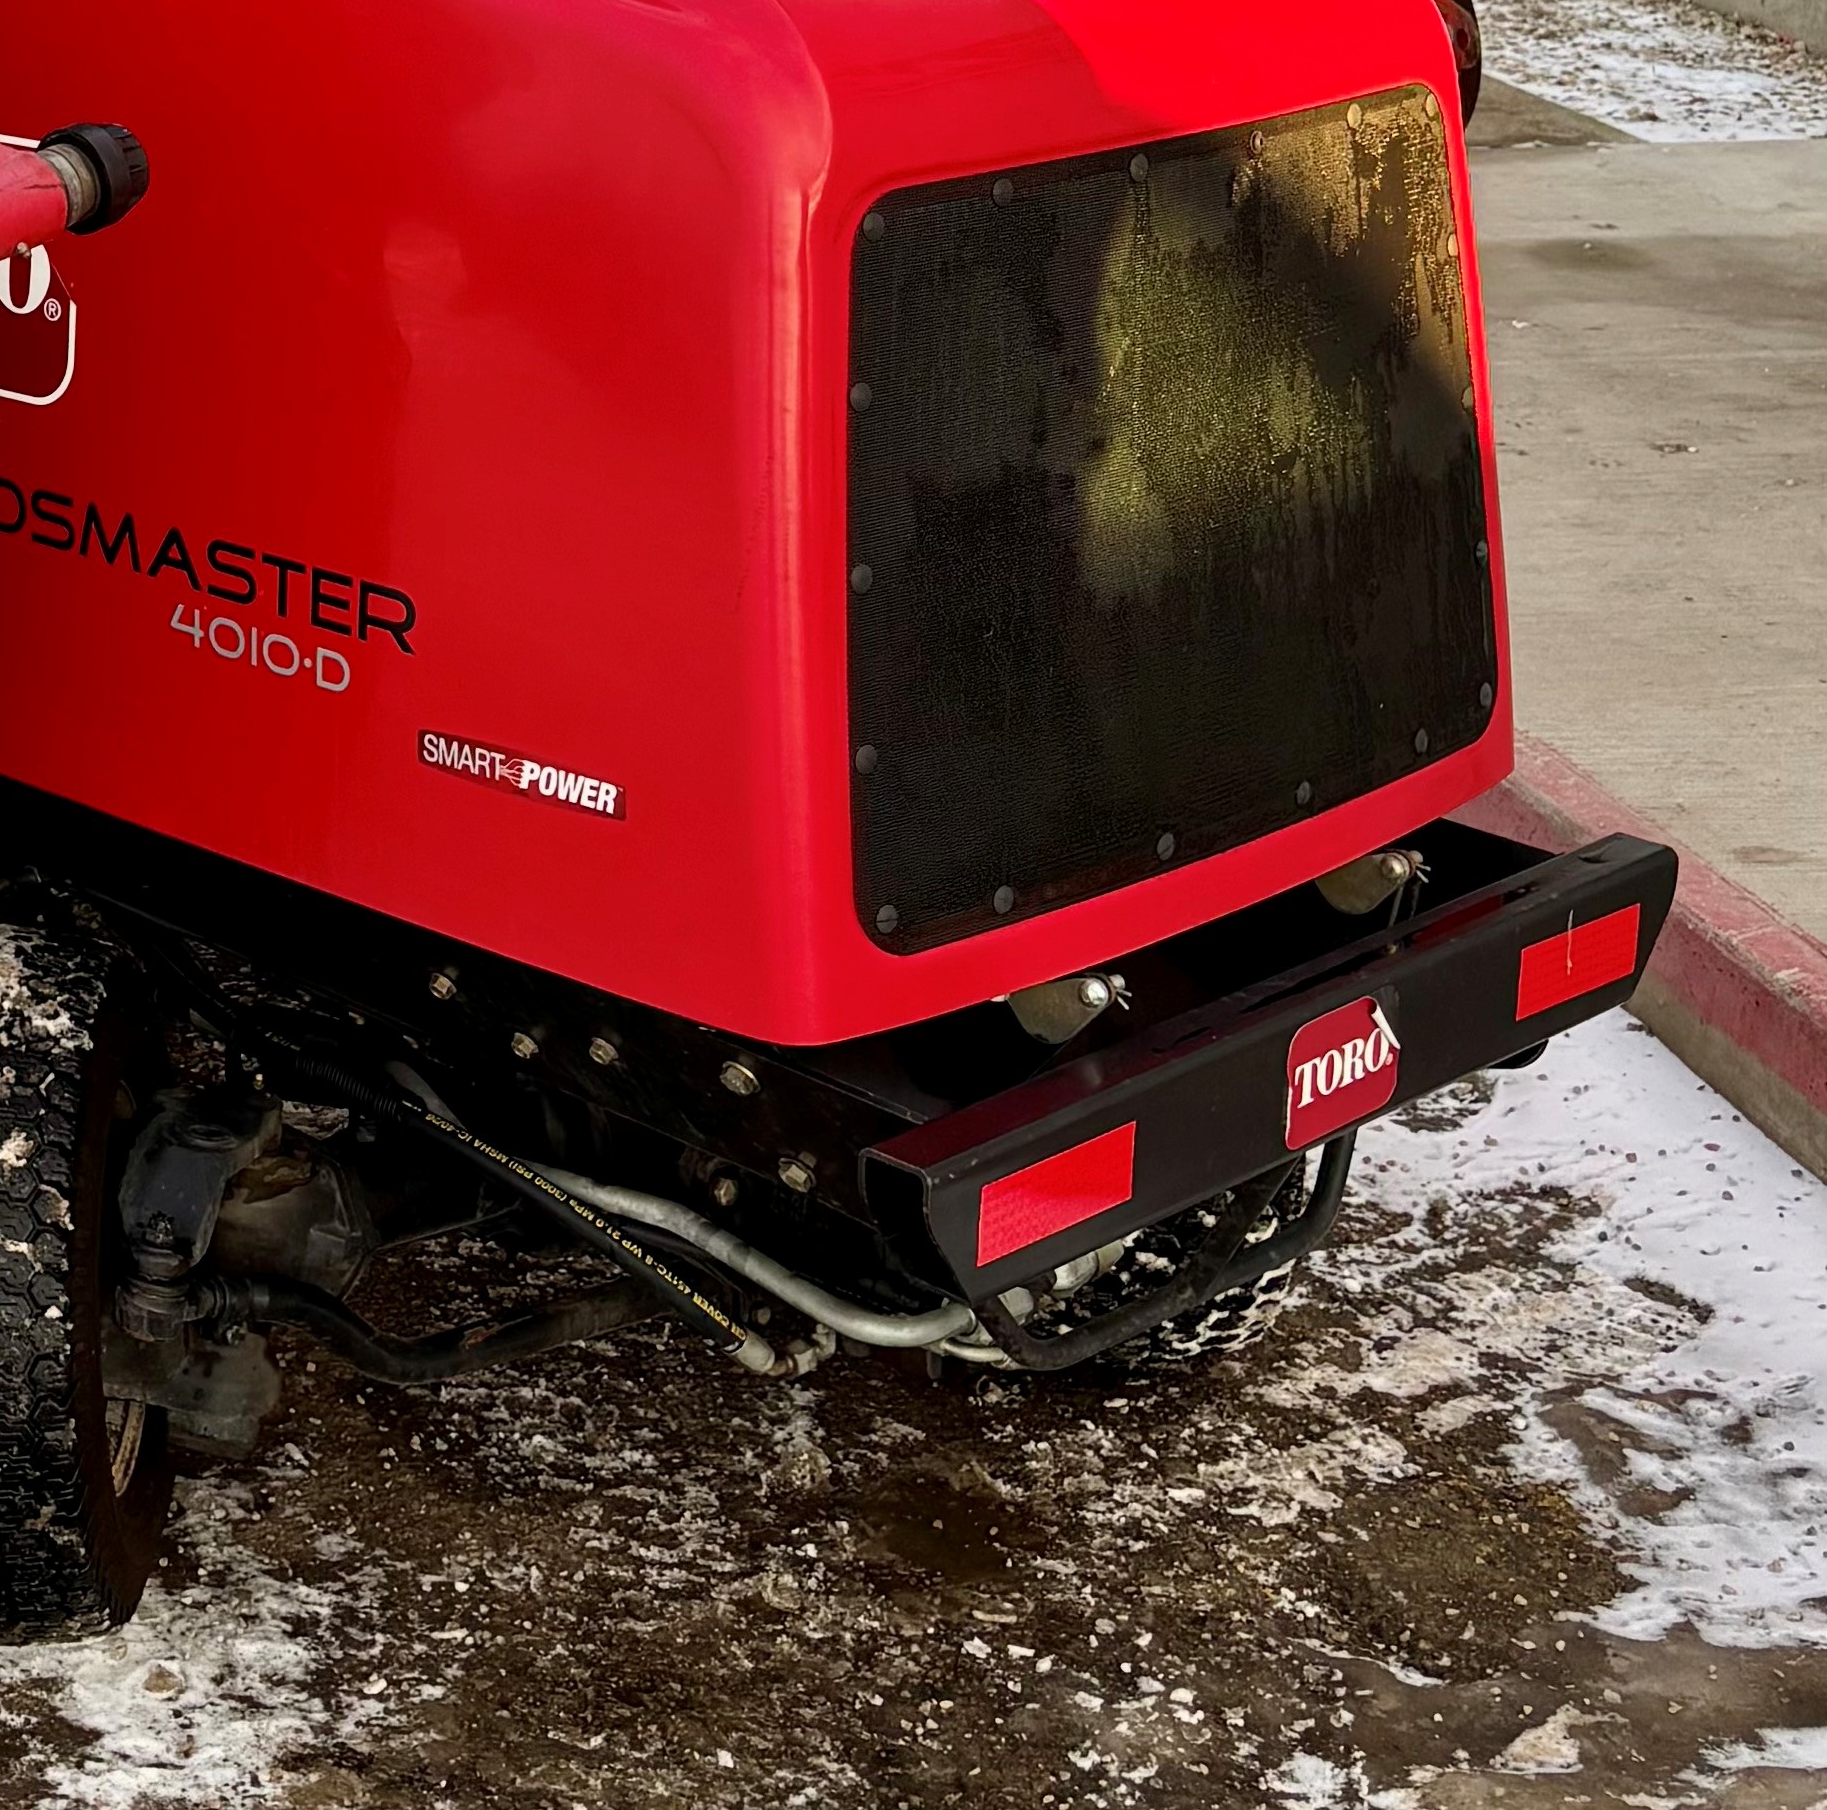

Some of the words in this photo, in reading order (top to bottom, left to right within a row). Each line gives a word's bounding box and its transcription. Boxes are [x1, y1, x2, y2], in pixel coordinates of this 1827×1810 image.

[422, 733, 506, 781] SMART
[519, 760, 619, 815] POWER
[1294, 1027, 1390, 1109] TORO
[473, 1139, 510, 1164] MSHA
[621, 1239, 643, 1258] WP
[692, 1292, 731, 1328] COVER
